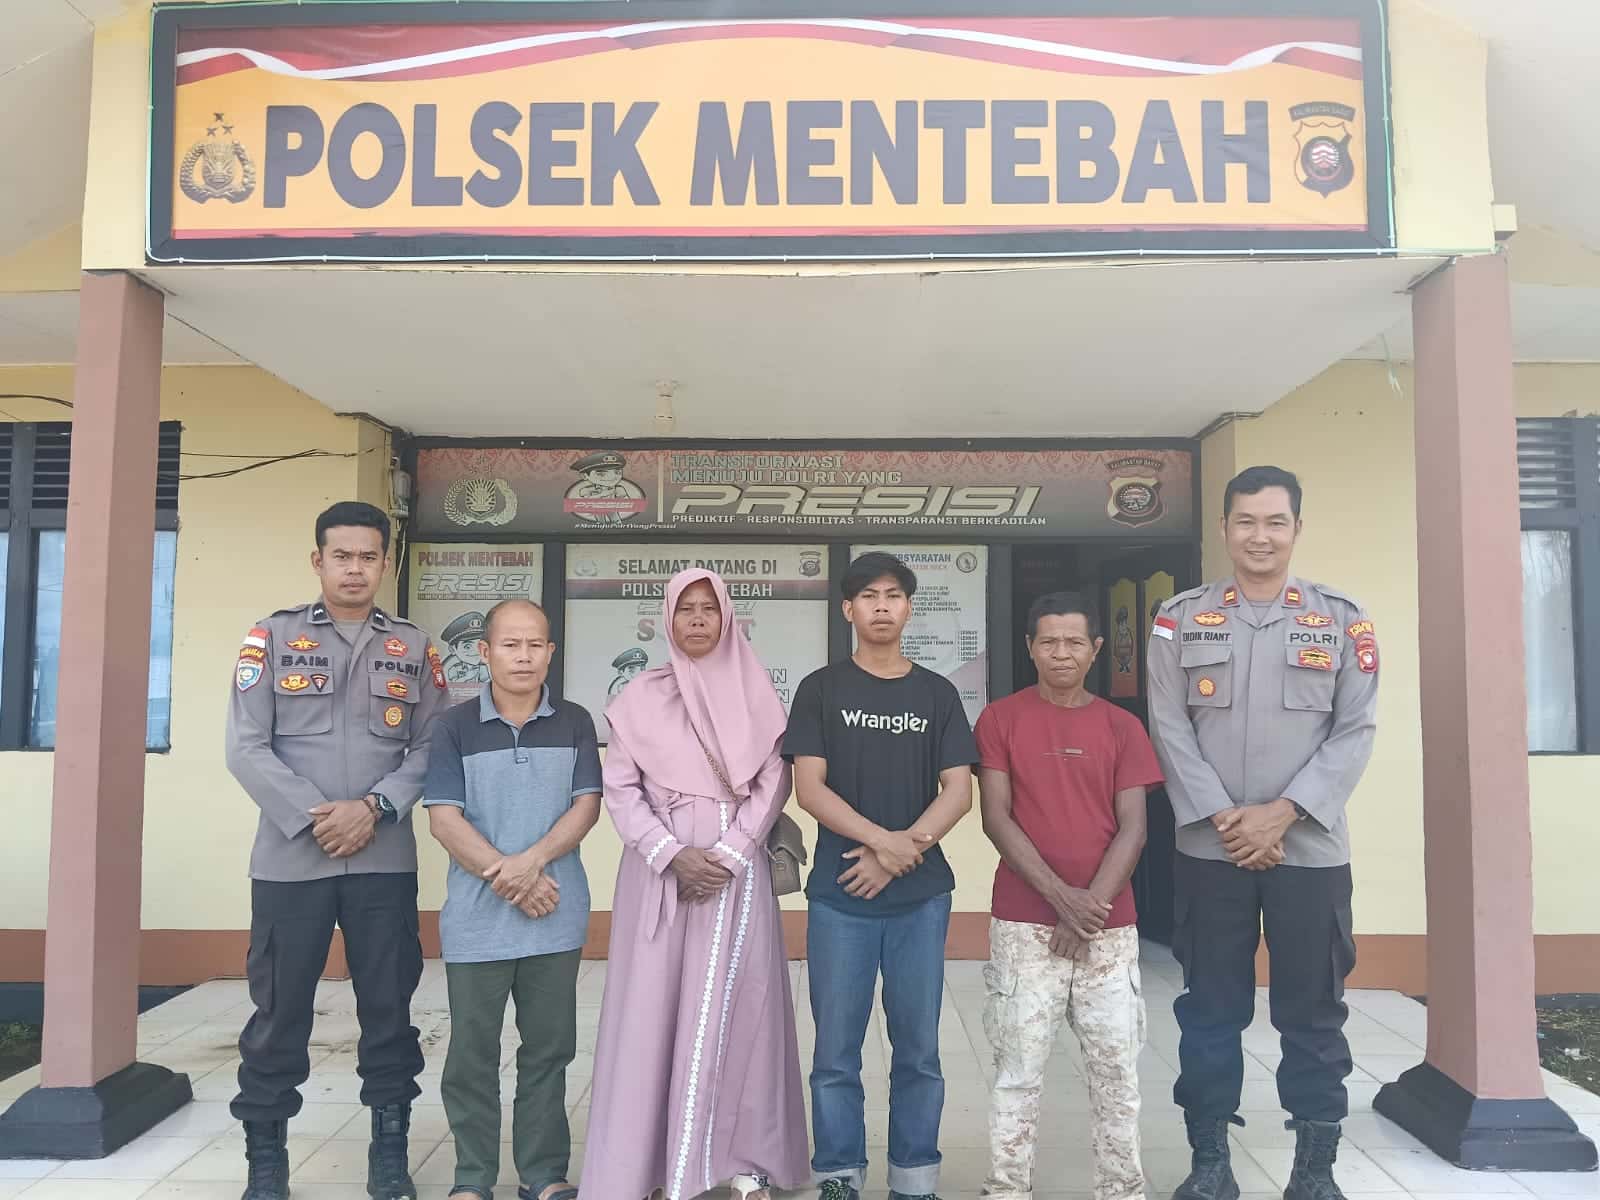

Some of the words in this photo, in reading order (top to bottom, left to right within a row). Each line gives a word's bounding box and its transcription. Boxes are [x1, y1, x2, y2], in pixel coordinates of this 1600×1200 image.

[263, 101, 661, 209] POLSEK
[690, 99, 1271, 206] MENTEBAH
[672, 455, 843, 469] TRANSFORMASI
[672, 469, 763, 483] MENUJU
[770, 471, 836, 484] POLRI
[842, 471, 902, 484] YANG
[672, 484, 1042, 517] PRESISI
[672, 515, 736, 523] PREDIKTIF
[747, 515, 855, 525] RESPONSIBILITAS
[866, 516, 958, 525] TRANSPARANSI
[961, 517, 1046, 526] BERKEADILAN
[418, 552, 466, 566] POLSEK
[468, 552, 533, 566] MENTEBAH
[618, 559, 690, 575] SELAMAT
[695, 559, 756, 575] DATANG
[761, 559, 777, 575] DI
[418, 574, 534, 592] PRESISI
[727, 583, 772, 597] EBAH
[1289, 632, 1337, 645] POLRI
[281, 655, 328, 667] BAIM
[374, 660, 418, 676] POLRI
[841, 709, 928, 734] Wrangler
